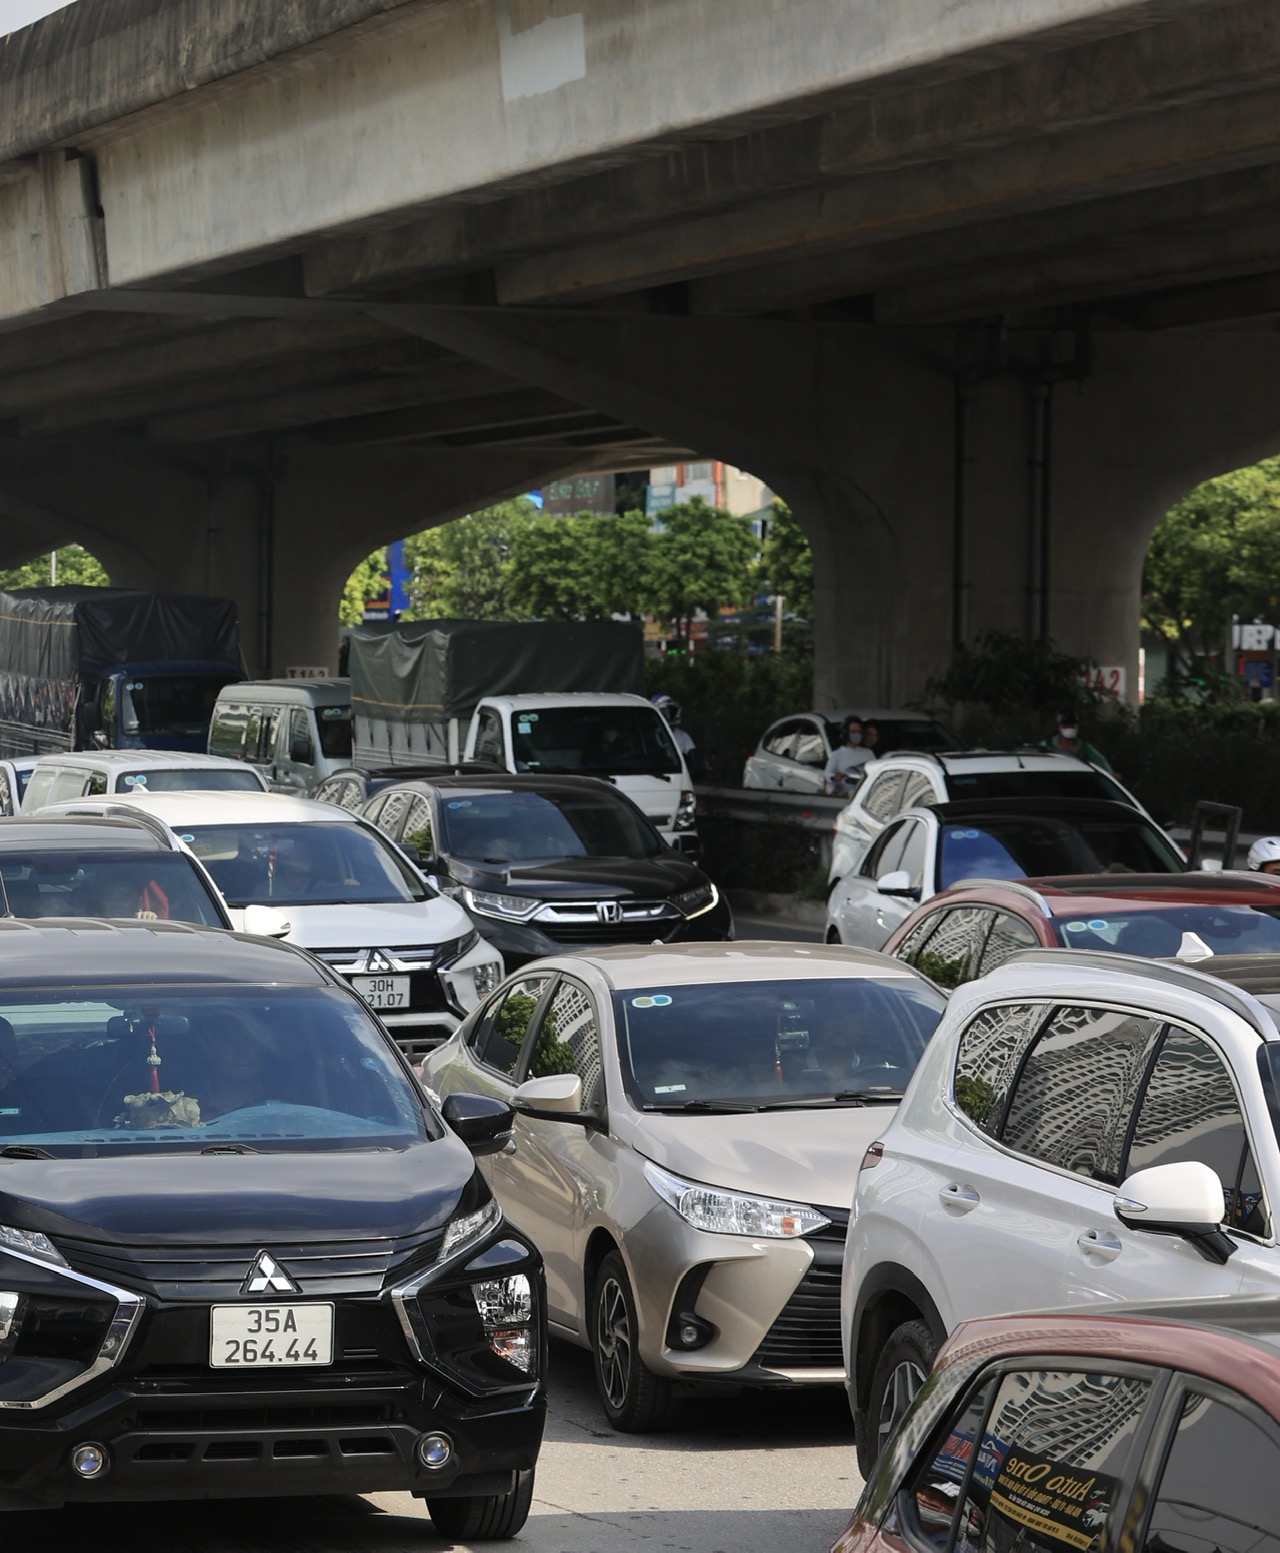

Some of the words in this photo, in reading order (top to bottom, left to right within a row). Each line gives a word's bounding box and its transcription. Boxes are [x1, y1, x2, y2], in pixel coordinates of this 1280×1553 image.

[369, 979, 394, 993] 30H
[360, 993, 404, 1007] 21.07
[247, 1309, 298, 1334] 35A
[224, 1337, 318, 1363] 264.44
